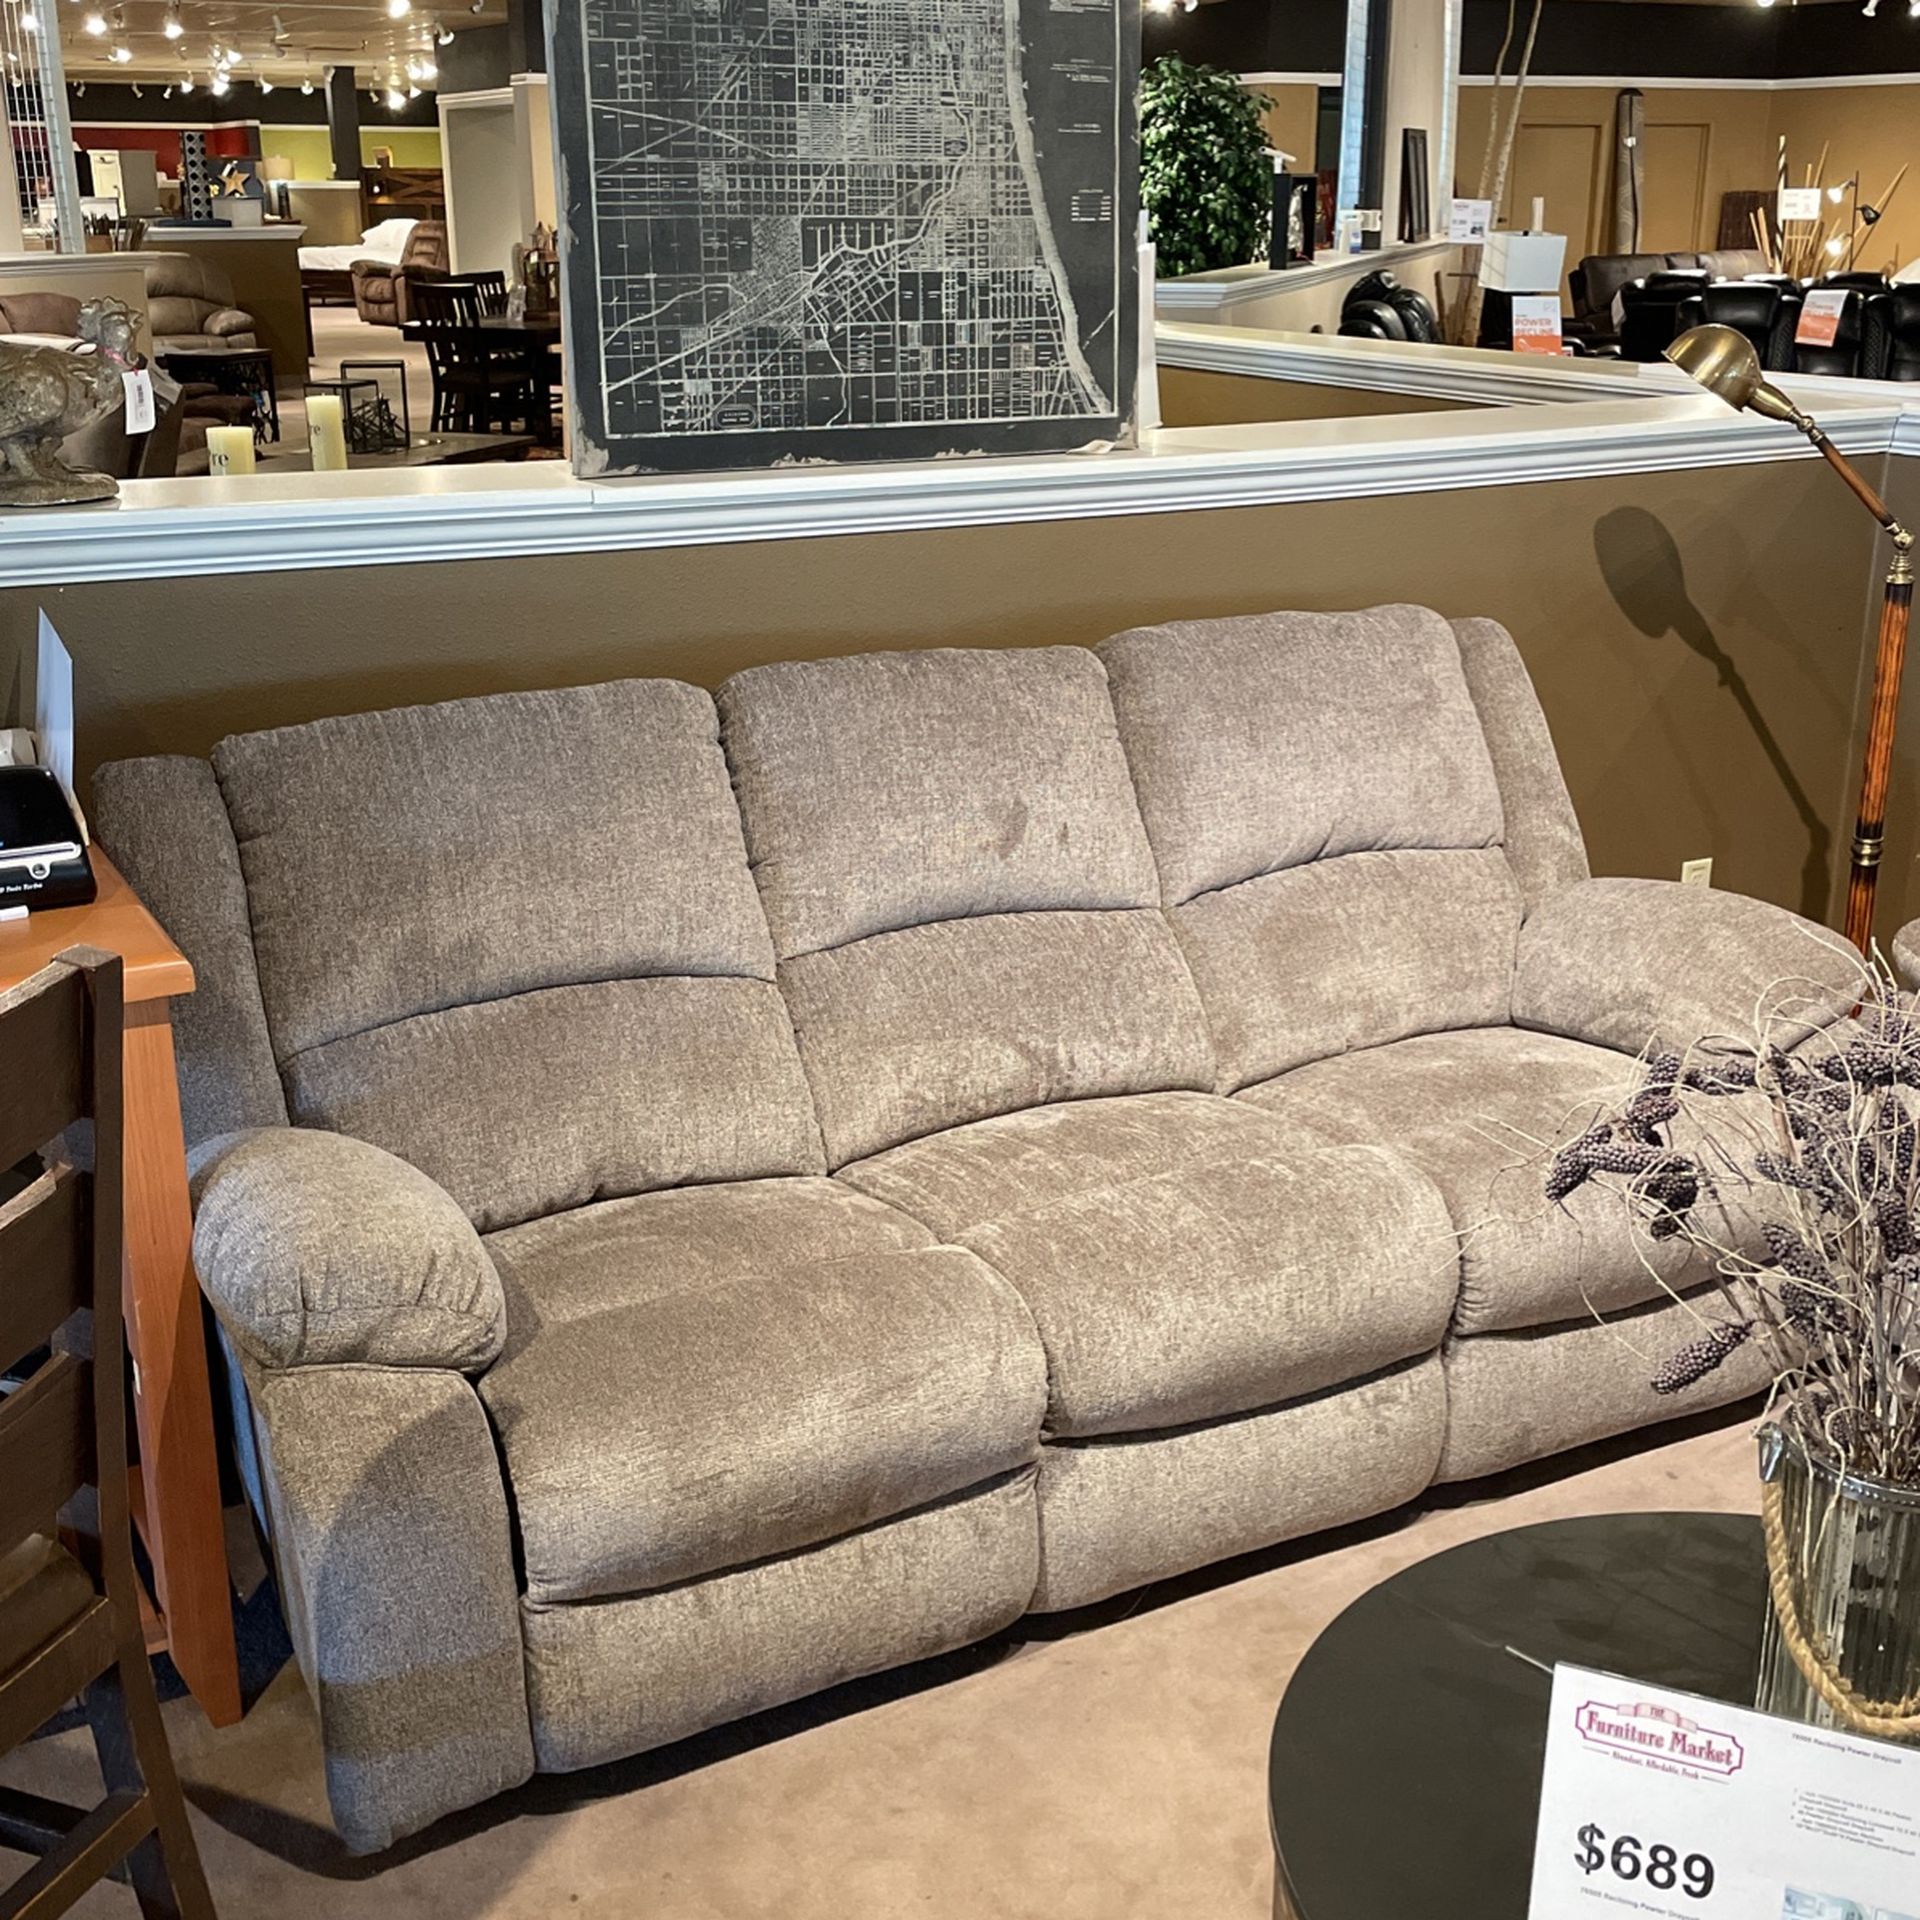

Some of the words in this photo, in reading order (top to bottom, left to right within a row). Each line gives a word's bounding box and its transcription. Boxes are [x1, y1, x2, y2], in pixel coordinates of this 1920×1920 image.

[1515, 318, 1552, 327] POWER
[1586, 1710, 1665, 1749] Furniture
[1668, 1731, 1733, 1766] Market
[1574, 1822, 1715, 1899] $689
